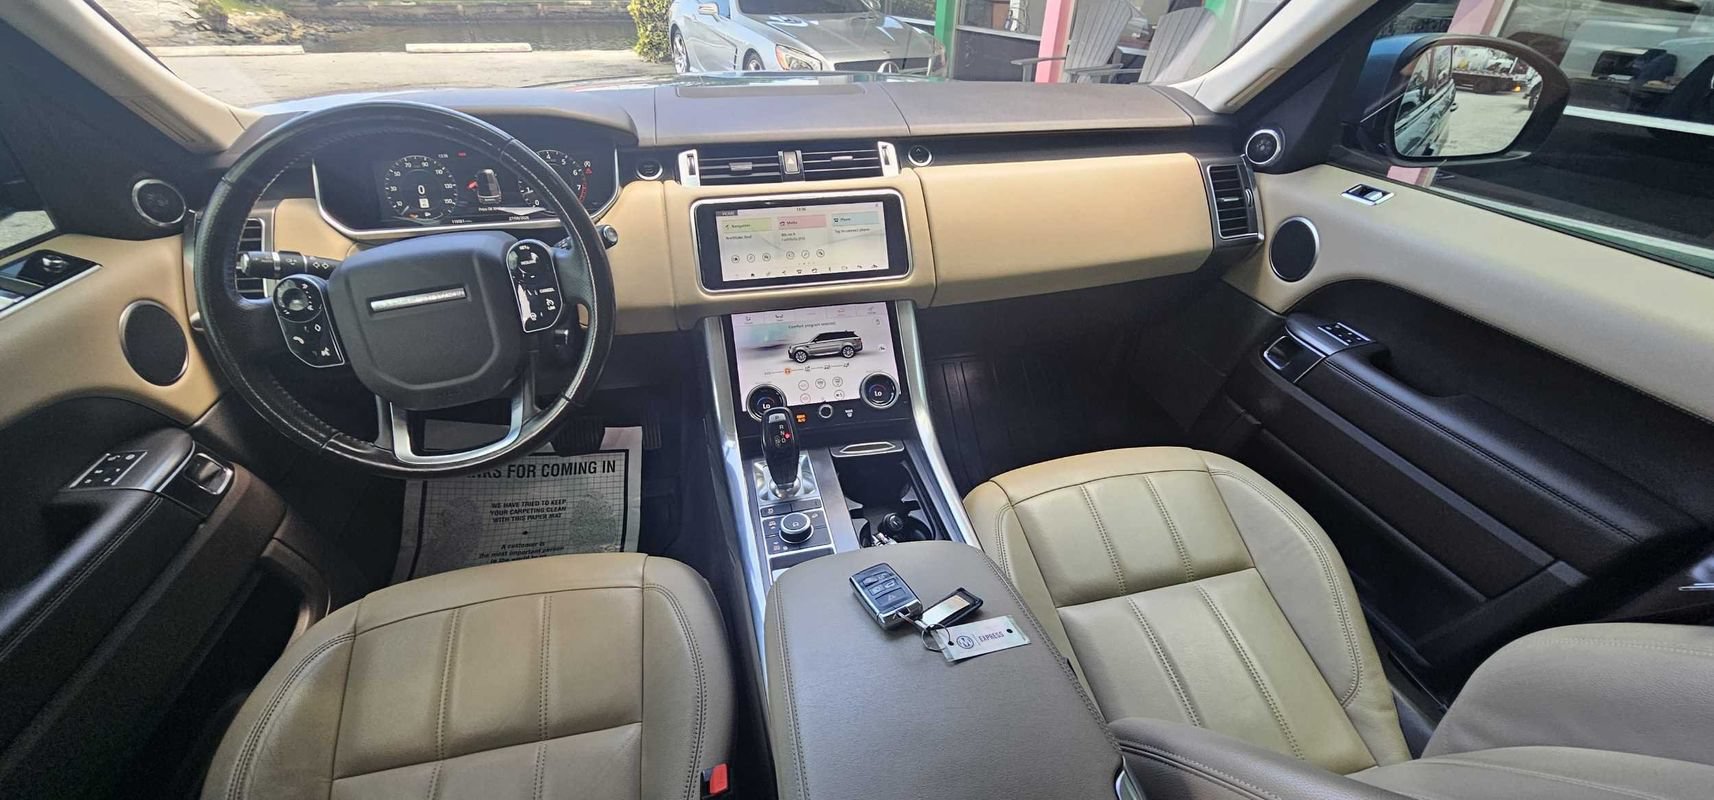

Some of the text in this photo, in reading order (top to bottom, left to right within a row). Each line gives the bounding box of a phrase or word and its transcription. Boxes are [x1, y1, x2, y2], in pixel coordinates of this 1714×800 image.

[417, 184, 425, 195] 0
[507, 464, 536, 479] FOR
[541, 461, 597, 478] COMING
[602, 460, 616, 473] IN
[509, 507, 545, 515] CARPETING
[509, 548, 543, 556] important
[978, 631, 1005, 643] EXPRESS
